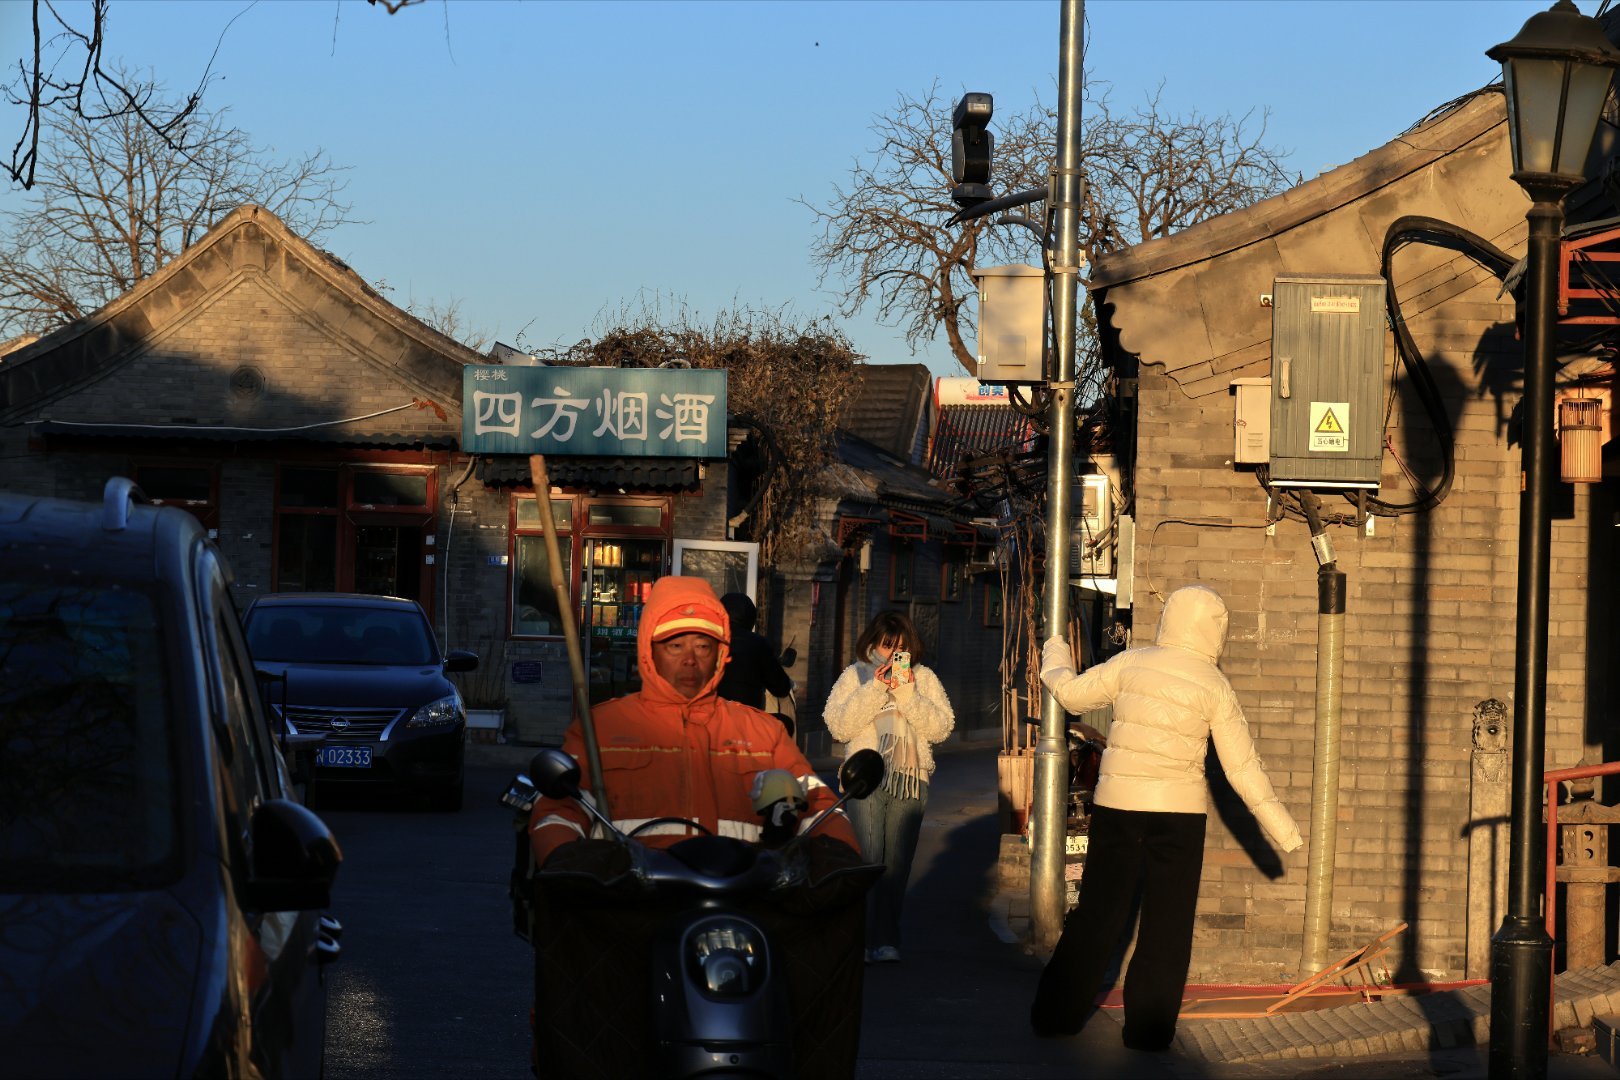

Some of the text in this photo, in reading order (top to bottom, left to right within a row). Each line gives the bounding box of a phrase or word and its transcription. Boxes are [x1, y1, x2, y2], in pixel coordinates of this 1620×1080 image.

[474, 369, 508, 381] 樱桃
[473, 386, 715, 444] 四方烟酒
